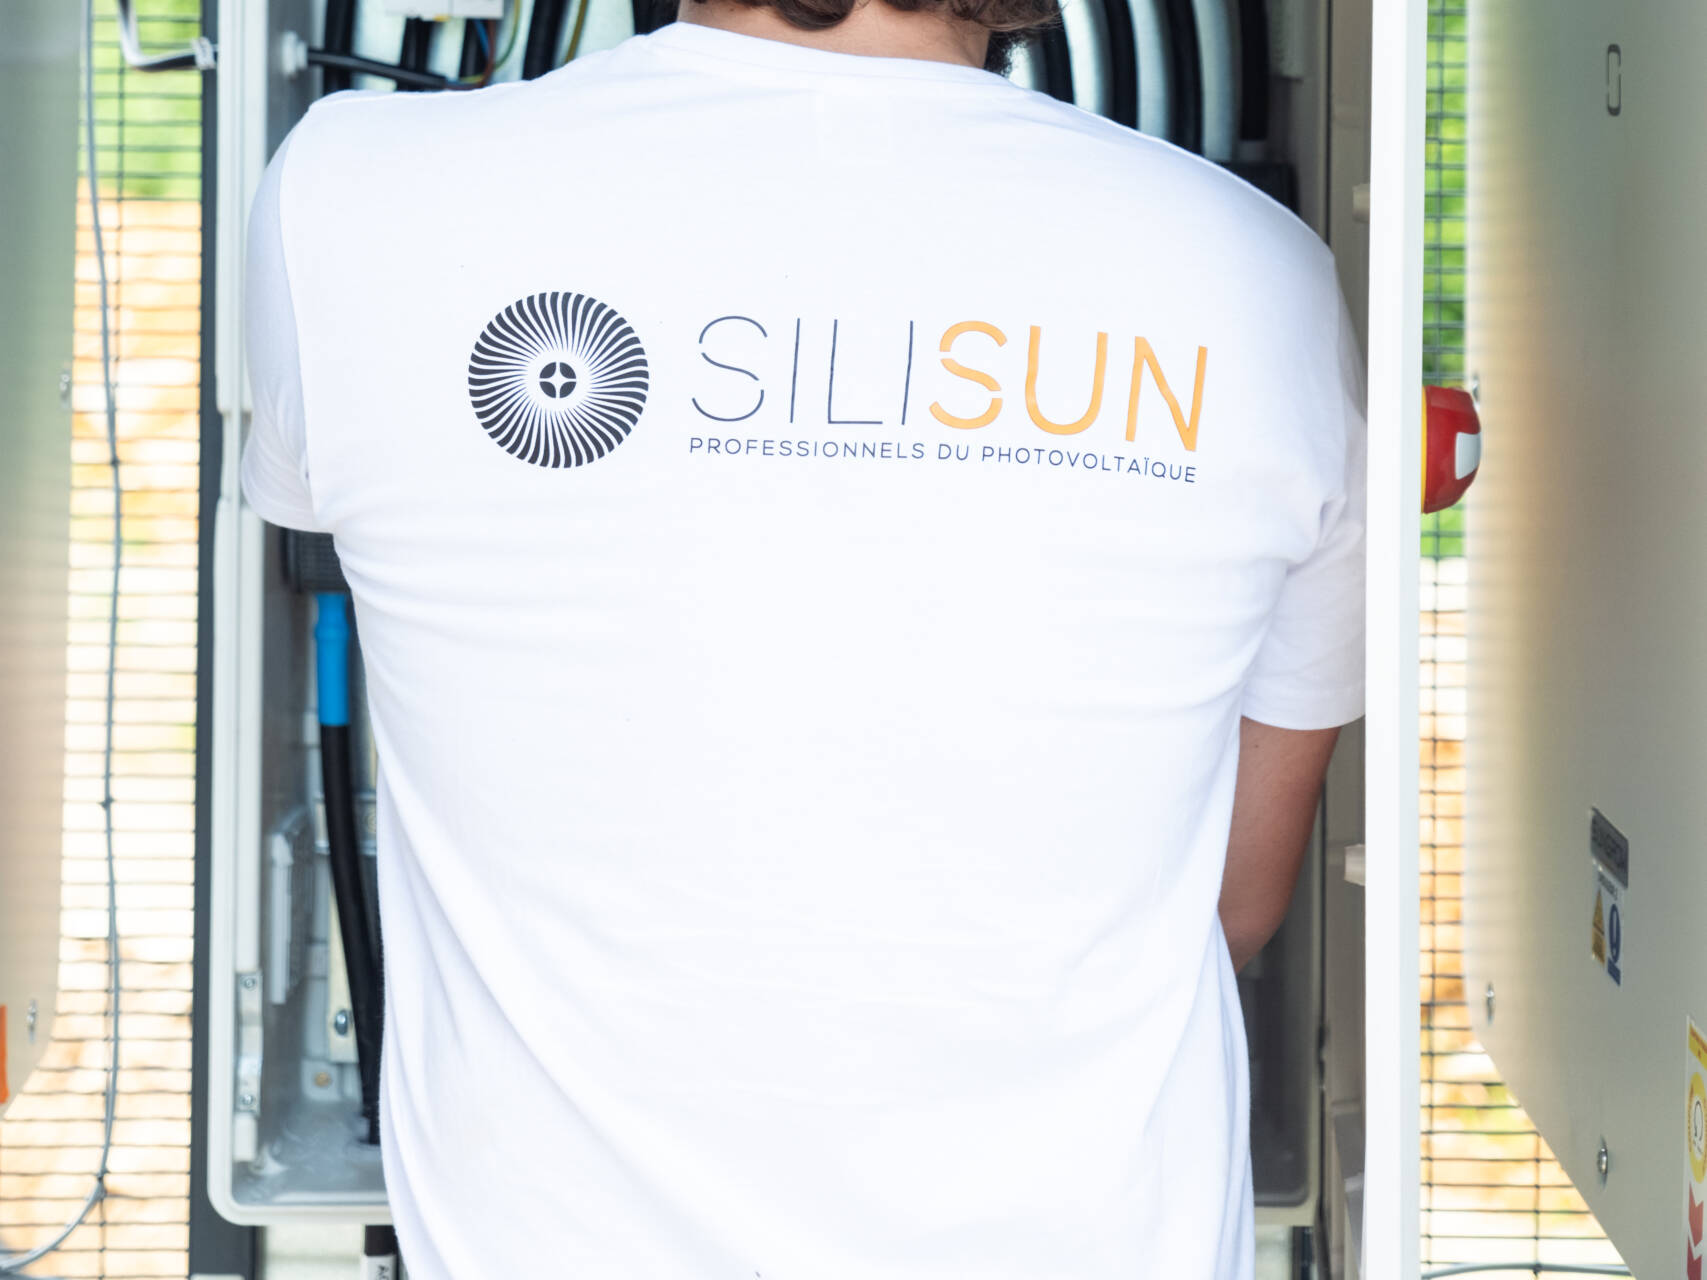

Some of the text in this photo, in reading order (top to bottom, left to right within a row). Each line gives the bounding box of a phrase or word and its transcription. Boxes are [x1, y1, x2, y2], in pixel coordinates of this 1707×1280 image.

[691, 315, 1208, 452] SILISUN
[689, 437, 1197, 484] PROFESSIONNELS DU PHOTOVOLTAÏQUE
